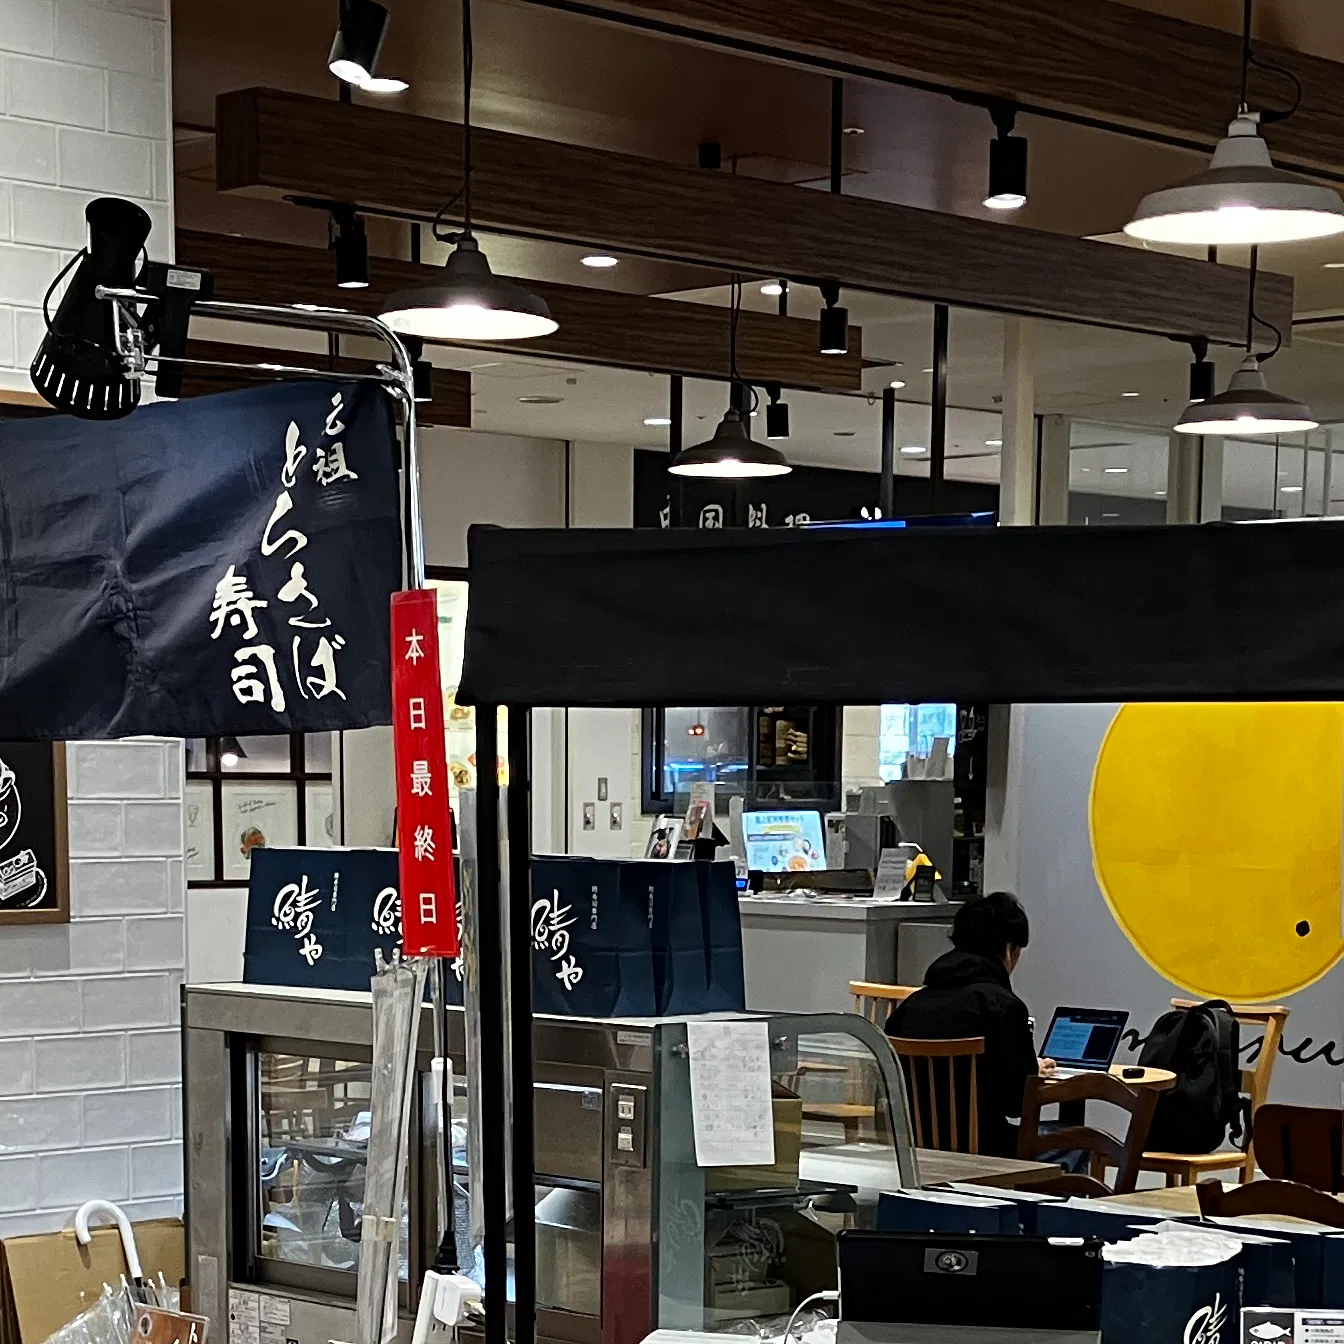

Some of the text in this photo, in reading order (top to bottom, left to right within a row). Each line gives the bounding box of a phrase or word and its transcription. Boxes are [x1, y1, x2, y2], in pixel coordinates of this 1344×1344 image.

[209, 565, 286, 713] 寿司
[404, 628, 437, 925] 本日最終日
[271, 874, 323, 966] 鯖や
[530, 888, 584, 991] 鯖や
